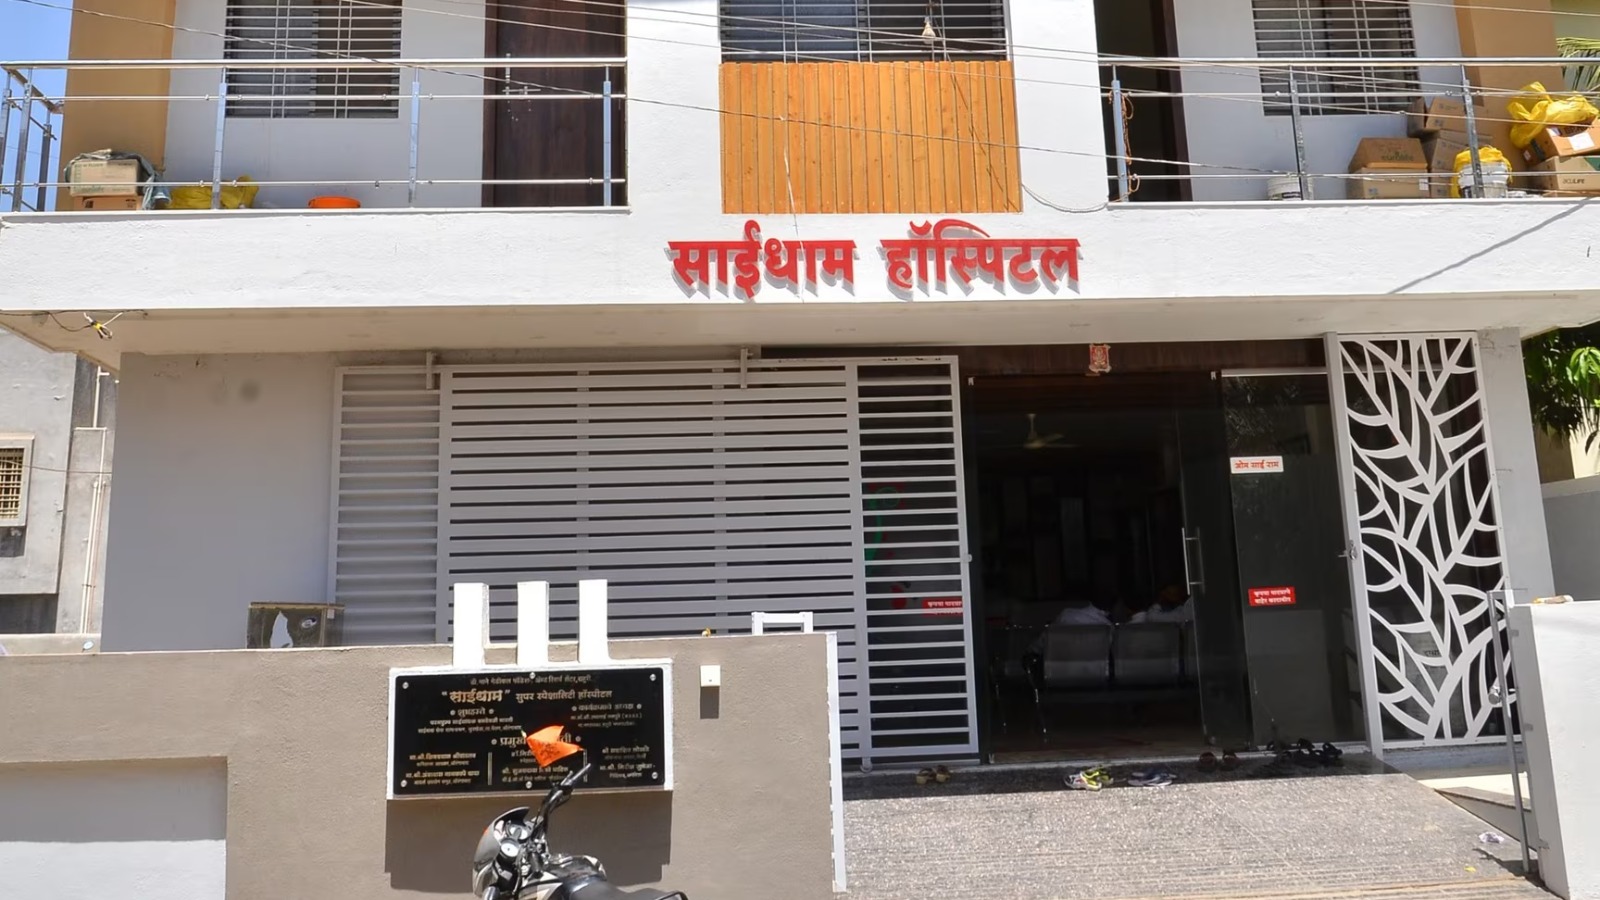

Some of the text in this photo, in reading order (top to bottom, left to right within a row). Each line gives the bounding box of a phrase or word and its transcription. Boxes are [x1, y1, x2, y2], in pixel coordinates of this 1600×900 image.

[668, 218, 1081, 299] साईधाम हॉस्पिटल
[515, 692, 535, 703] सुपर
